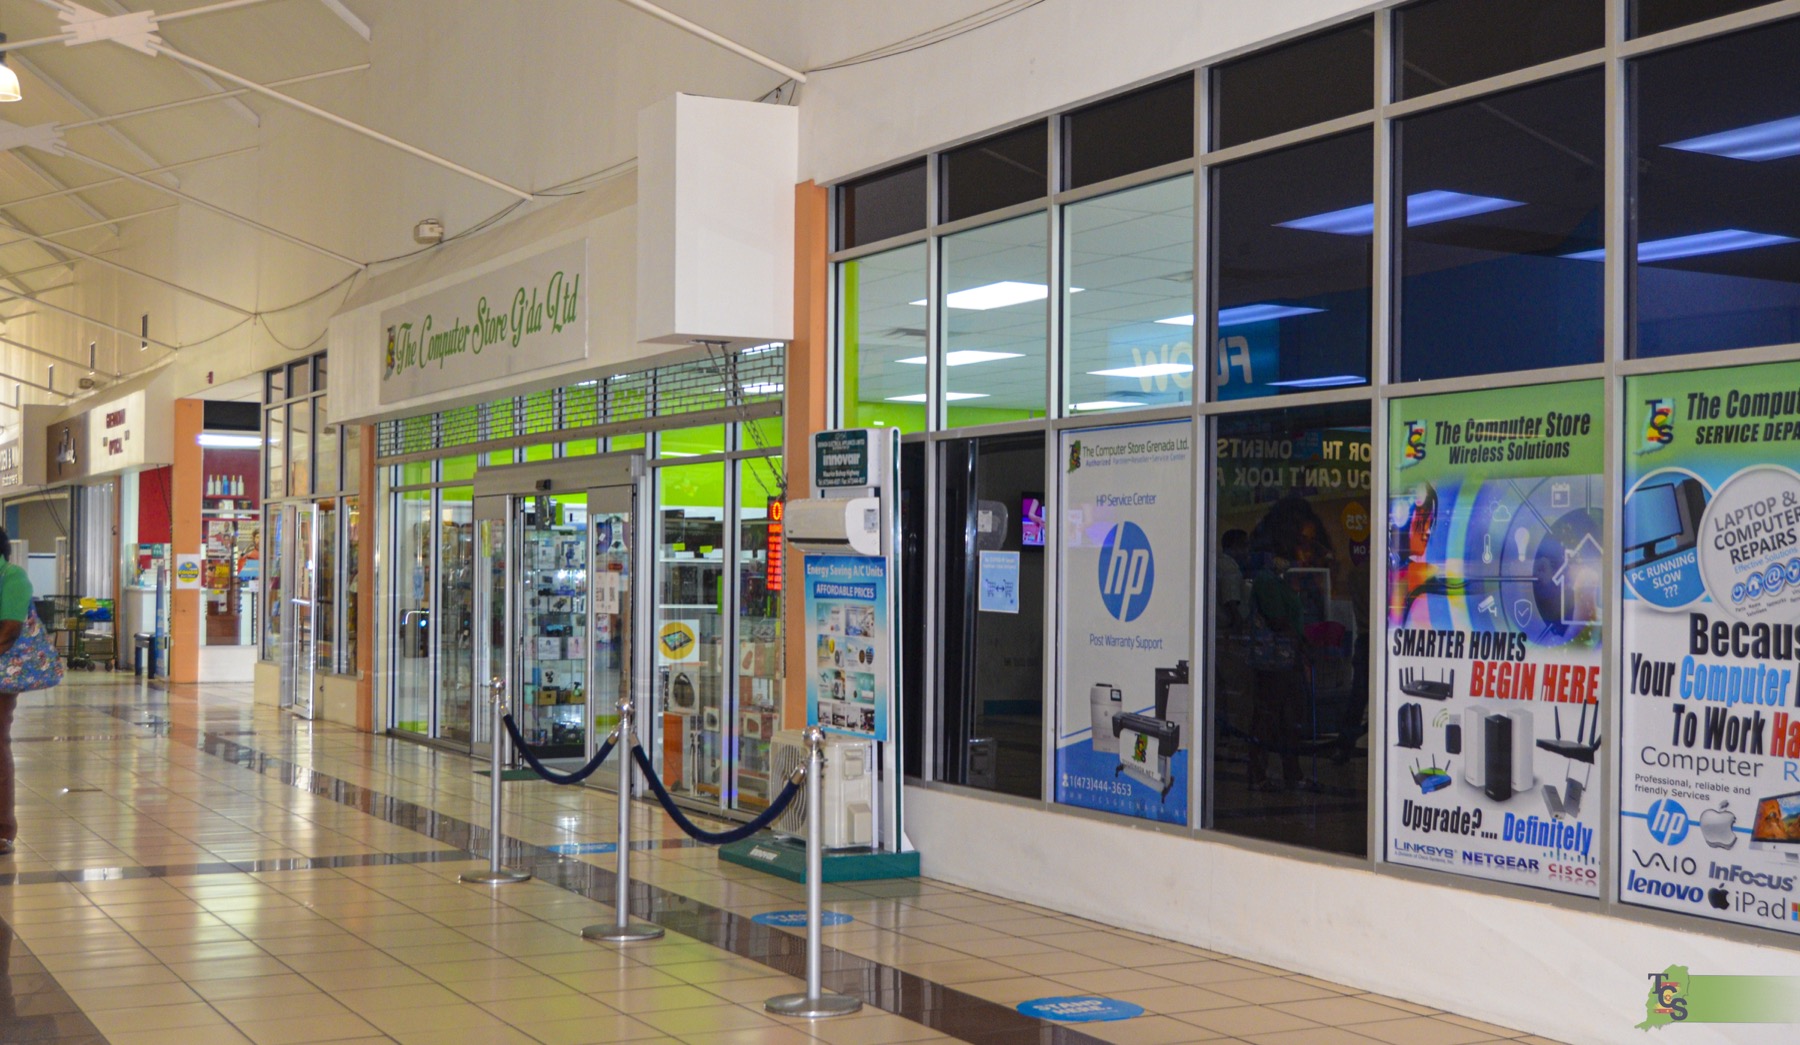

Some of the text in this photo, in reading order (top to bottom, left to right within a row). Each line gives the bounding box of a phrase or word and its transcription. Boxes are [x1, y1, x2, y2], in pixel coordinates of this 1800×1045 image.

[396, 271, 580, 374] The Computer Store G'da Ltd
[1687, 392, 1721, 420] The
[1435, 412, 1590, 445] The Computer Store
[1696, 421, 1800, 444] SERVICE DEPA
[1083, 438, 1189, 458] The Computer Store Grenada Ltd.
[1449, 440, 1570, 464] Wireless Solutions
[1096, 492, 1156, 506] HP Service Center
[1714, 491, 1797, 532] LAPTOP &
[1714, 506, 1800, 550] COMPUTER
[1730, 528, 1797, 565] REPAIRS
[1734, 546, 1798, 574] Effective Solutions
[807, 564, 884, 578] Energy Saving A/C Units
[1102, 520, 1150, 622] hp
[1632, 552, 1695, 584] PC RUNNING
[1652, 570, 1681, 588] SLOW
[816, 584, 874, 598] AFFORDABLE PRICES
[1664, 585, 1678, 598] ???
[1090, 634, 1163, 650] Post Warranty Support
[1393, 628, 1527, 661] SMARTER HOMES
[1470, 660, 1600, 704] BEGIN HERE
[1631, 652, 1676, 697] Your
[1680, 655, 1791, 707] Computer
[1672, 704, 1800, 758] To Work Ha
[1641, 746, 1800, 782] Computer R
[1070, 776, 1132, 796] 1(473)444-3653
[1634, 784, 1710, 800] friendly Services
[1635, 774, 1750, 795] Professional, reliable and
[1502, 812, 1593, 856] Definitely
[1650, 799, 1688, 845] hp
[1394, 838, 1596, 879] LINKSYS NETGEAR CISCO
[1632, 849, 1696, 875] VAIO
[1627, 869, 1786, 920] lenovo iPad
